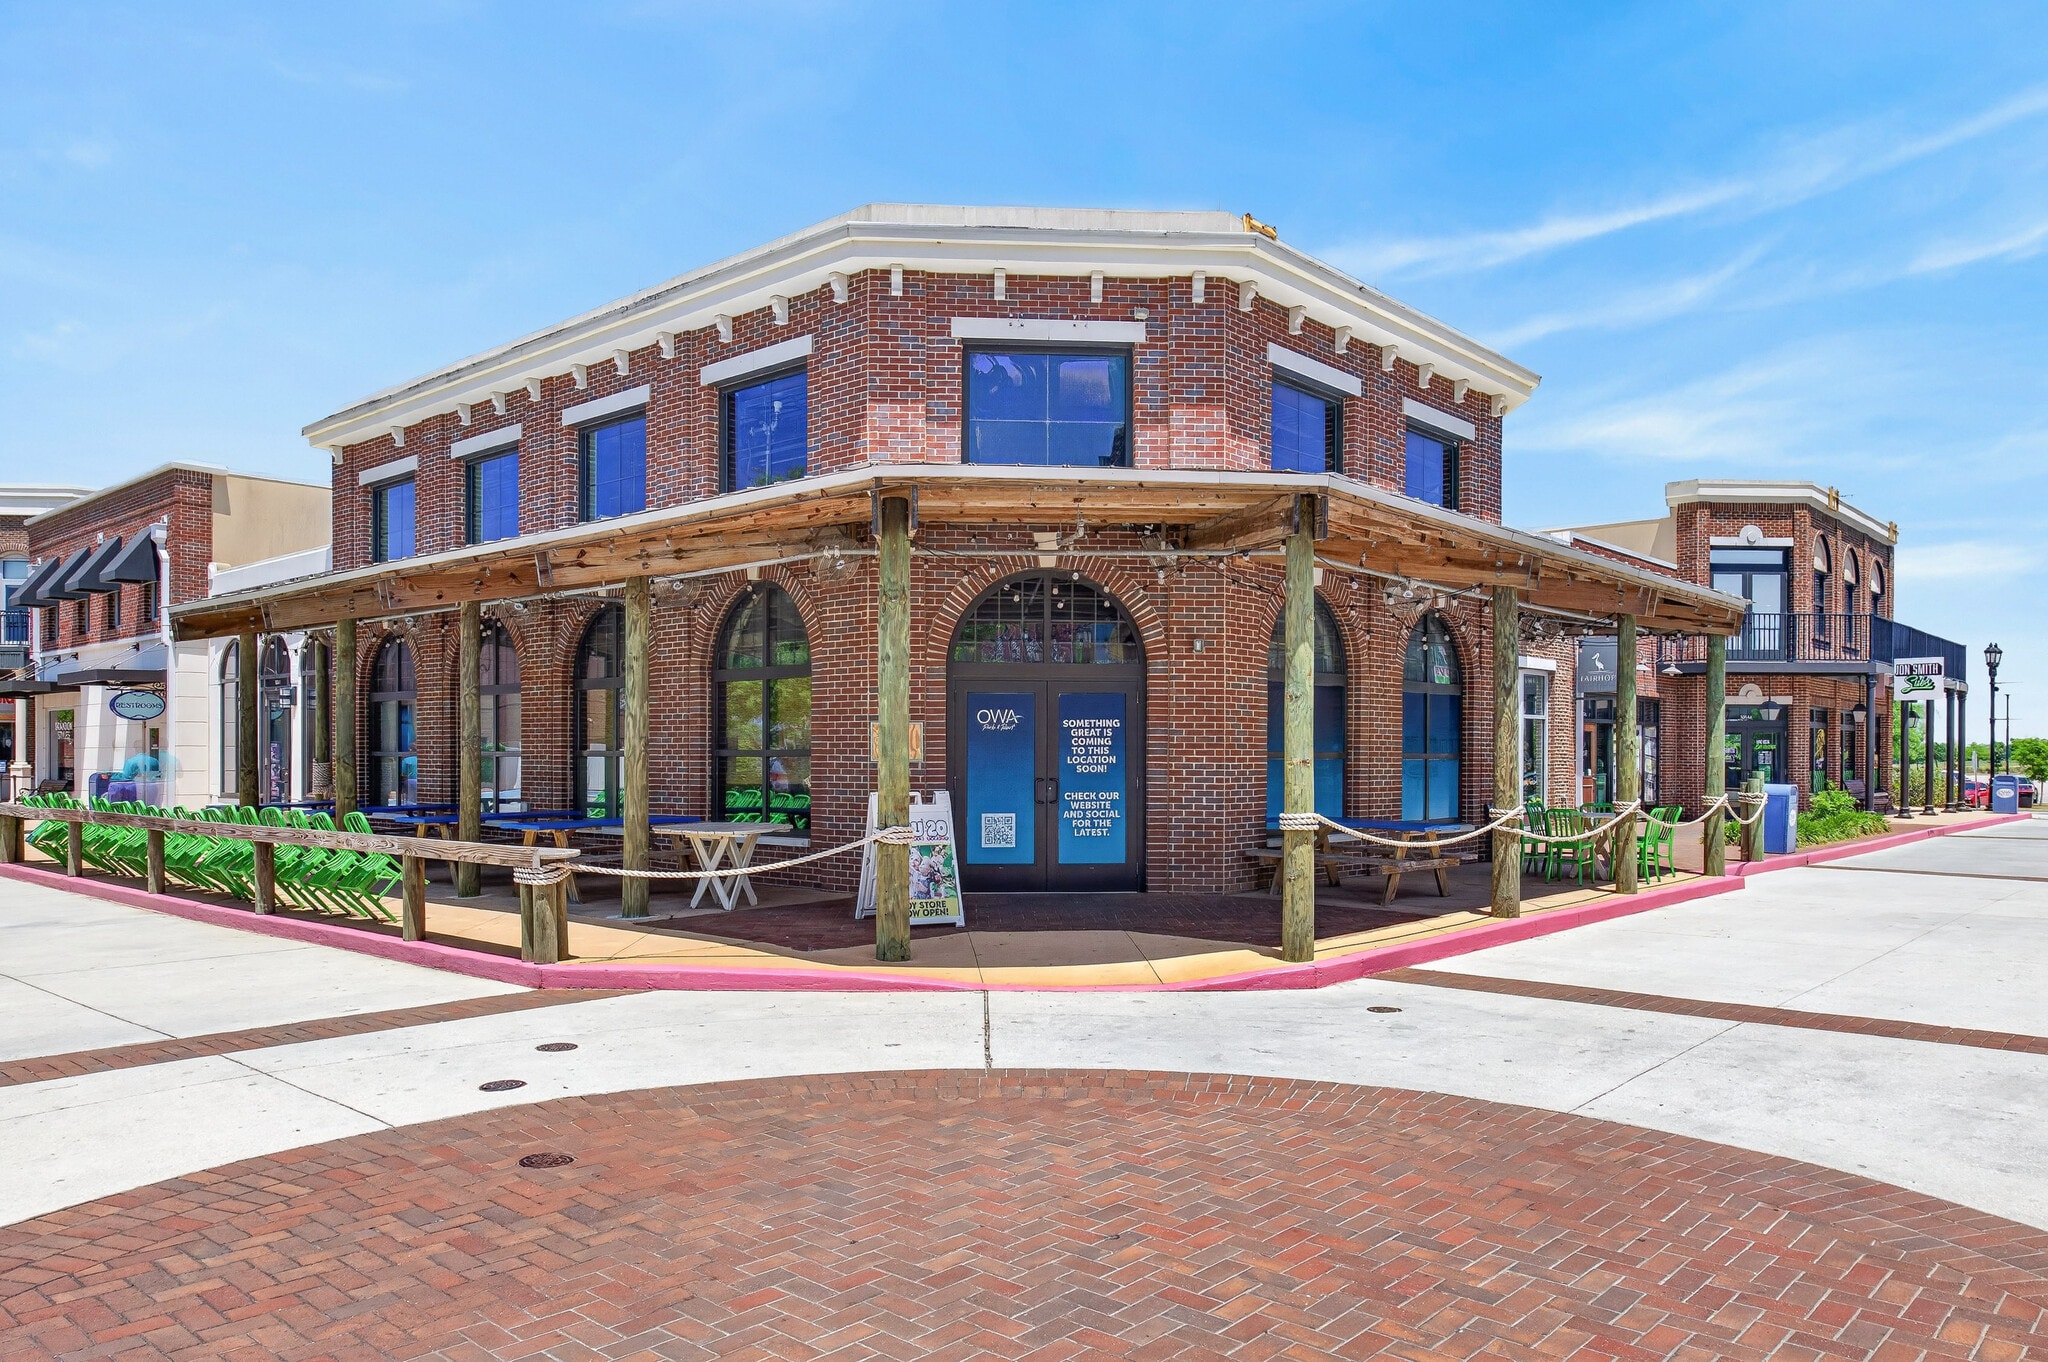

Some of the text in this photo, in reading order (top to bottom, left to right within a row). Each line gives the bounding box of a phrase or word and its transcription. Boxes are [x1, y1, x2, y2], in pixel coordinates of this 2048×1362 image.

[1895, 663, 1942, 676] JON SMITH
[1900, 675, 1935, 694] Subs
[976, 709, 1024, 724] OWA
[1062, 719, 1121, 728] SOMETHING
[1070, 728, 1113, 737] GREAT IS
[1071, 737, 1112, 746] COMING
[1071, 746, 1110, 755] TO THIS
[1067, 755, 1117, 764] LOCATION
[1076, 764, 1108, 773] SOON!
[1064, 791, 1120, 801] CHECK OUR
[1070, 801, 1111, 810] WEBSITE
[1063, 810, 1121, 819] AND SOCIAL
[1072, 819, 1112, 828] FOR THE
[1074, 828, 1110, 837] LATEST.
[919, 900, 947, 909] STORE
[922, 908, 949, 917] OPEN!
